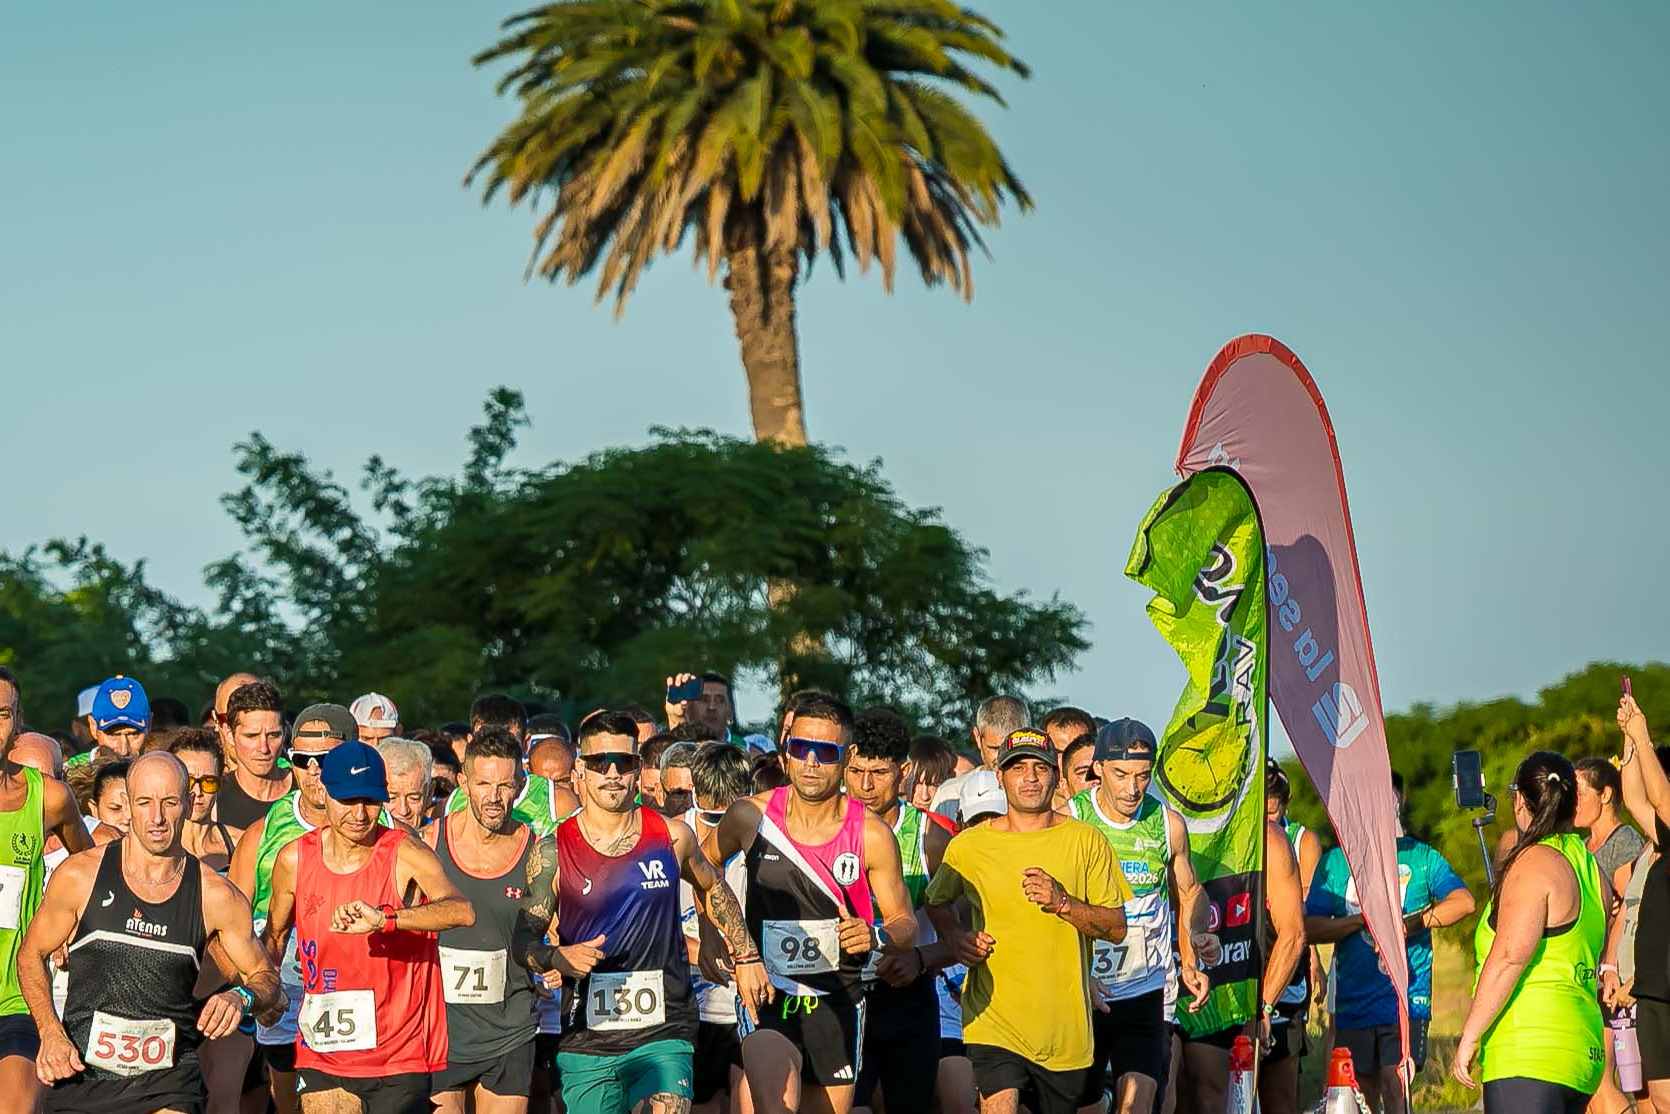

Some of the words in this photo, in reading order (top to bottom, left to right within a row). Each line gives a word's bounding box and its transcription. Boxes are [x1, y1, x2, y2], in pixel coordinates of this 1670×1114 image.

[638, 859, 666, 880] VR
[640, 880, 669, 890] TEAM
[126, 918, 168, 937] ATENAS
[780, 936, 822, 962] 98
[1094, 946, 1129, 974] 37
[453, 965, 488, 991] 71
[593, 987, 657, 1016] 130
[312, 1008, 356, 1038] 45
[94, 1030, 166, 1065] 530
[1588, 1047, 1606, 1062] STAF
